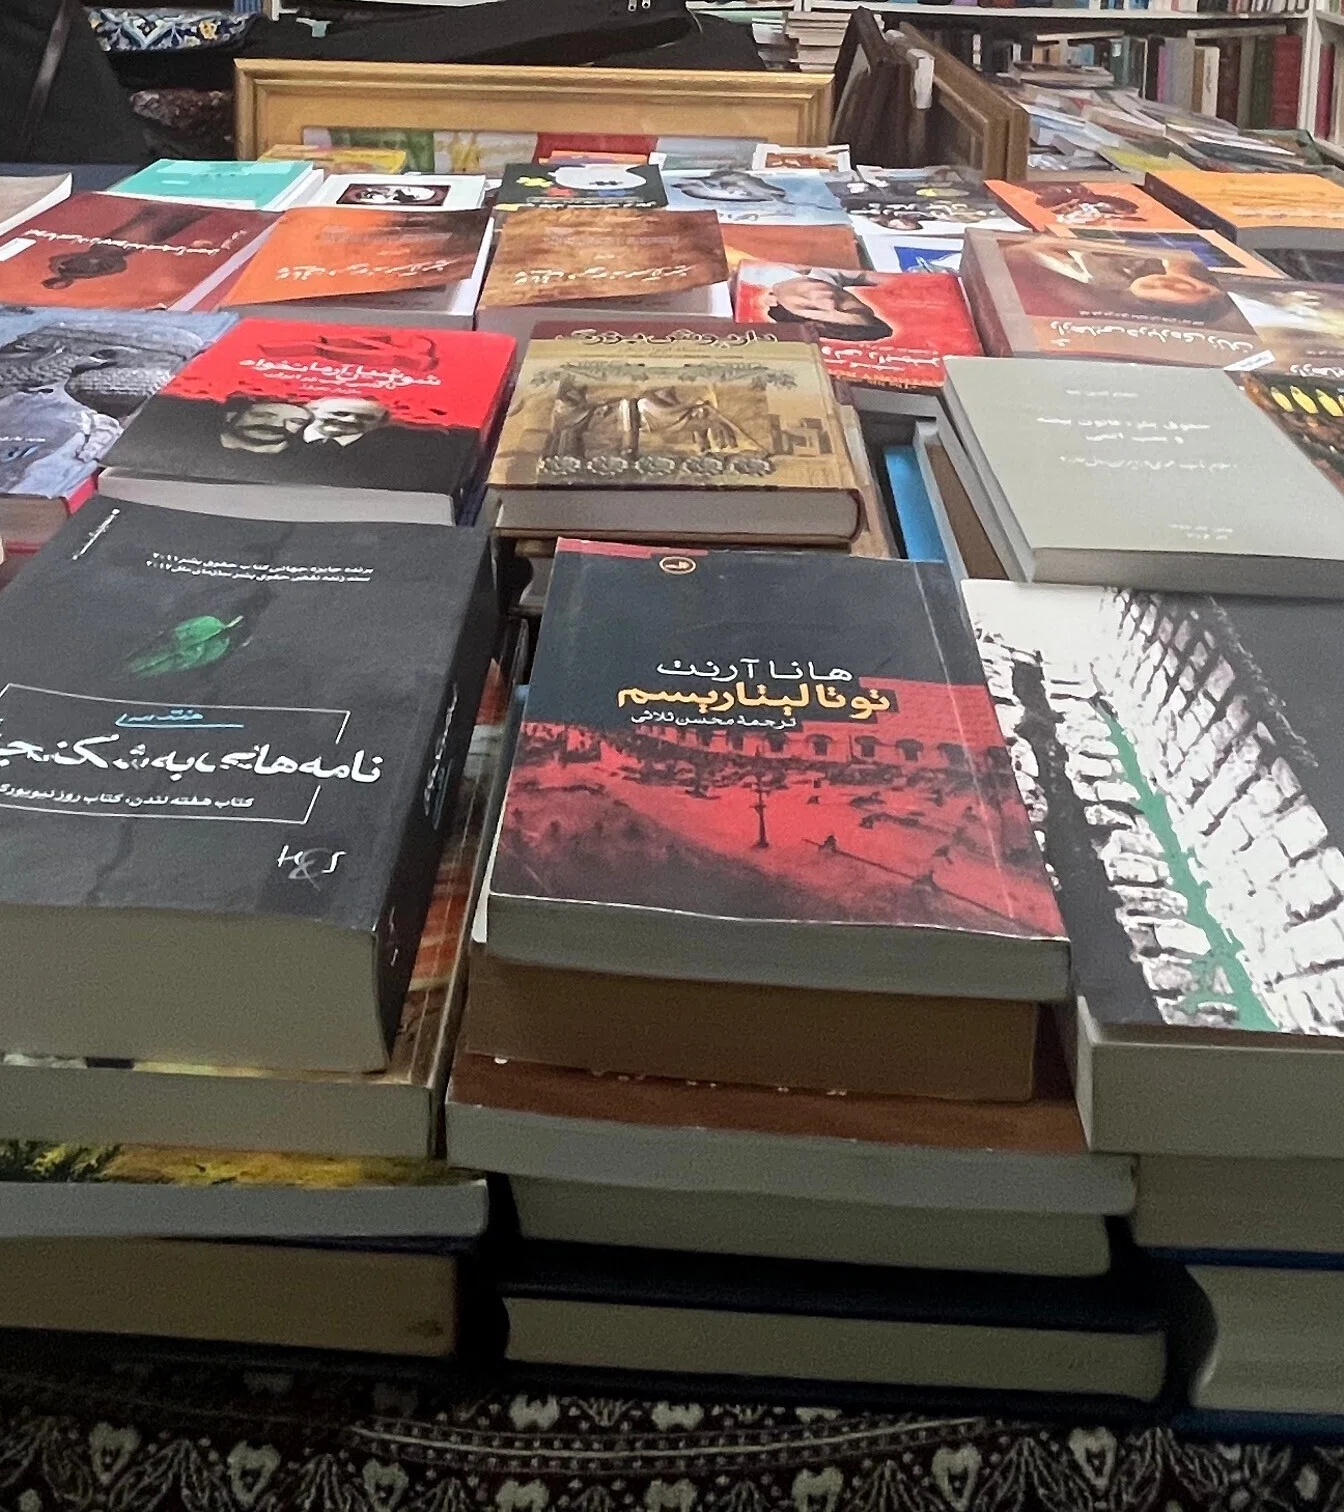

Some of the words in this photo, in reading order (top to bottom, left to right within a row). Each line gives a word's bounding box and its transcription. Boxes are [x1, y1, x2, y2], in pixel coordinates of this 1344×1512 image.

[656, 657, 761, 683] آرنت
[768, 659, 854, 682] هانا
[617, 681, 892, 720] توتالیتاریسم
[630, 709, 675, 725] ثلاثی
[674, 711, 736, 727] محسن
[84, 789, 125, 807] کتاب
[169, 794, 212, 807] هفته
[214, 796, 255, 809] کتاب
